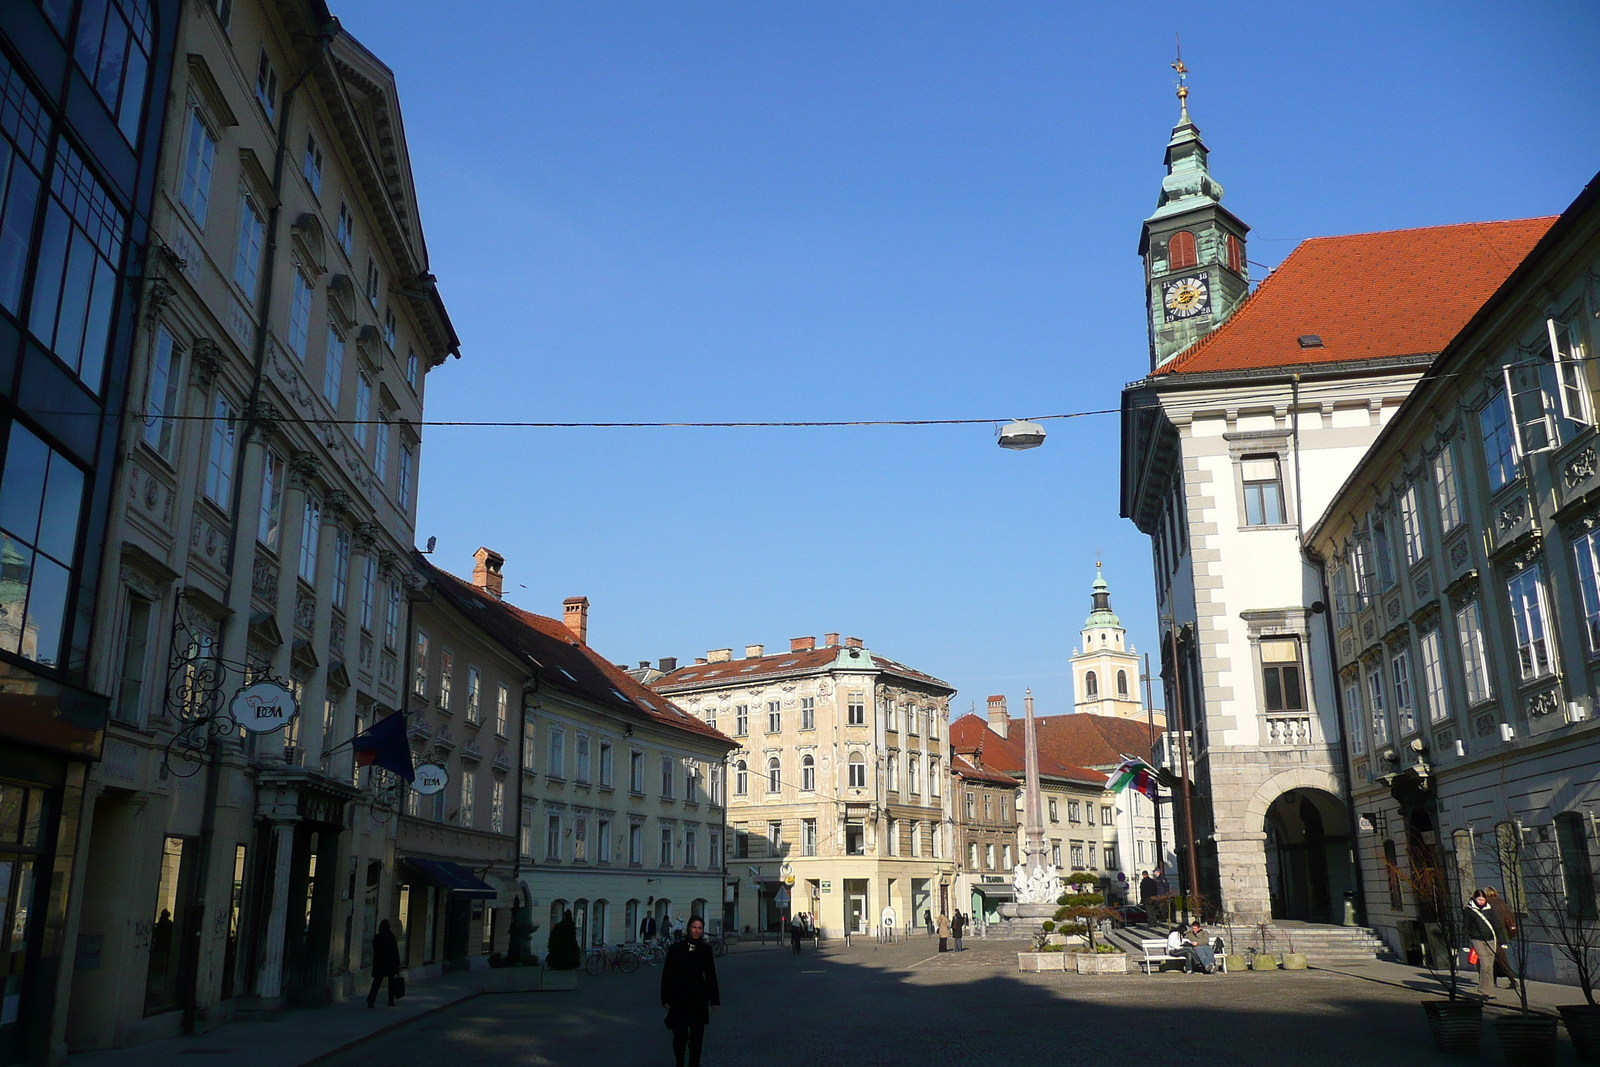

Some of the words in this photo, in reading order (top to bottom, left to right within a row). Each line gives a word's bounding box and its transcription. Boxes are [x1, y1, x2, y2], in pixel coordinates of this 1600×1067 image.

[1199, 272, 1208, 280] 18
[1165, 315, 1175, 323] 19
[256, 705, 283, 718] DOM
